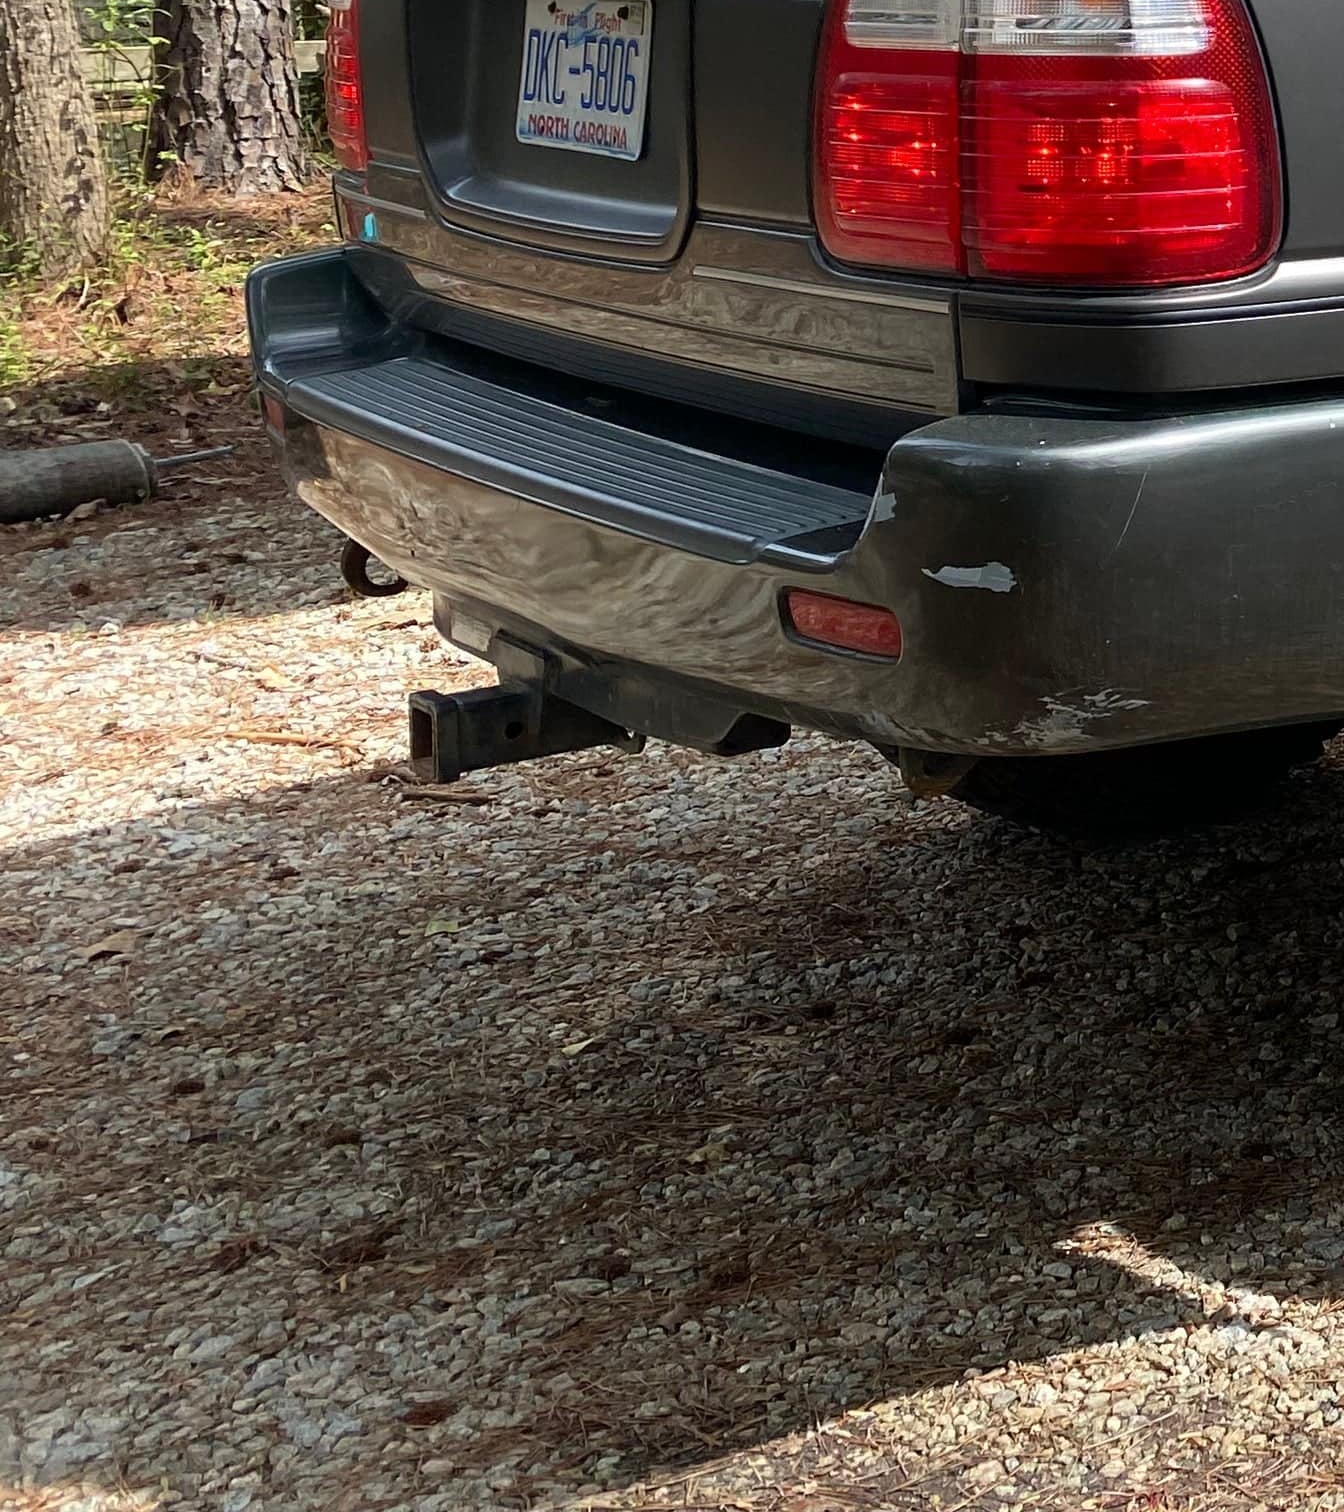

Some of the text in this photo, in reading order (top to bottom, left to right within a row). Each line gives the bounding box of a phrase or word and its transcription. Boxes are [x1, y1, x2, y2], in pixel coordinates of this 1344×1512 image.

[523, 28, 639, 115] DKC-5806
[527, 114, 628, 150] NORTH CAROLINA
